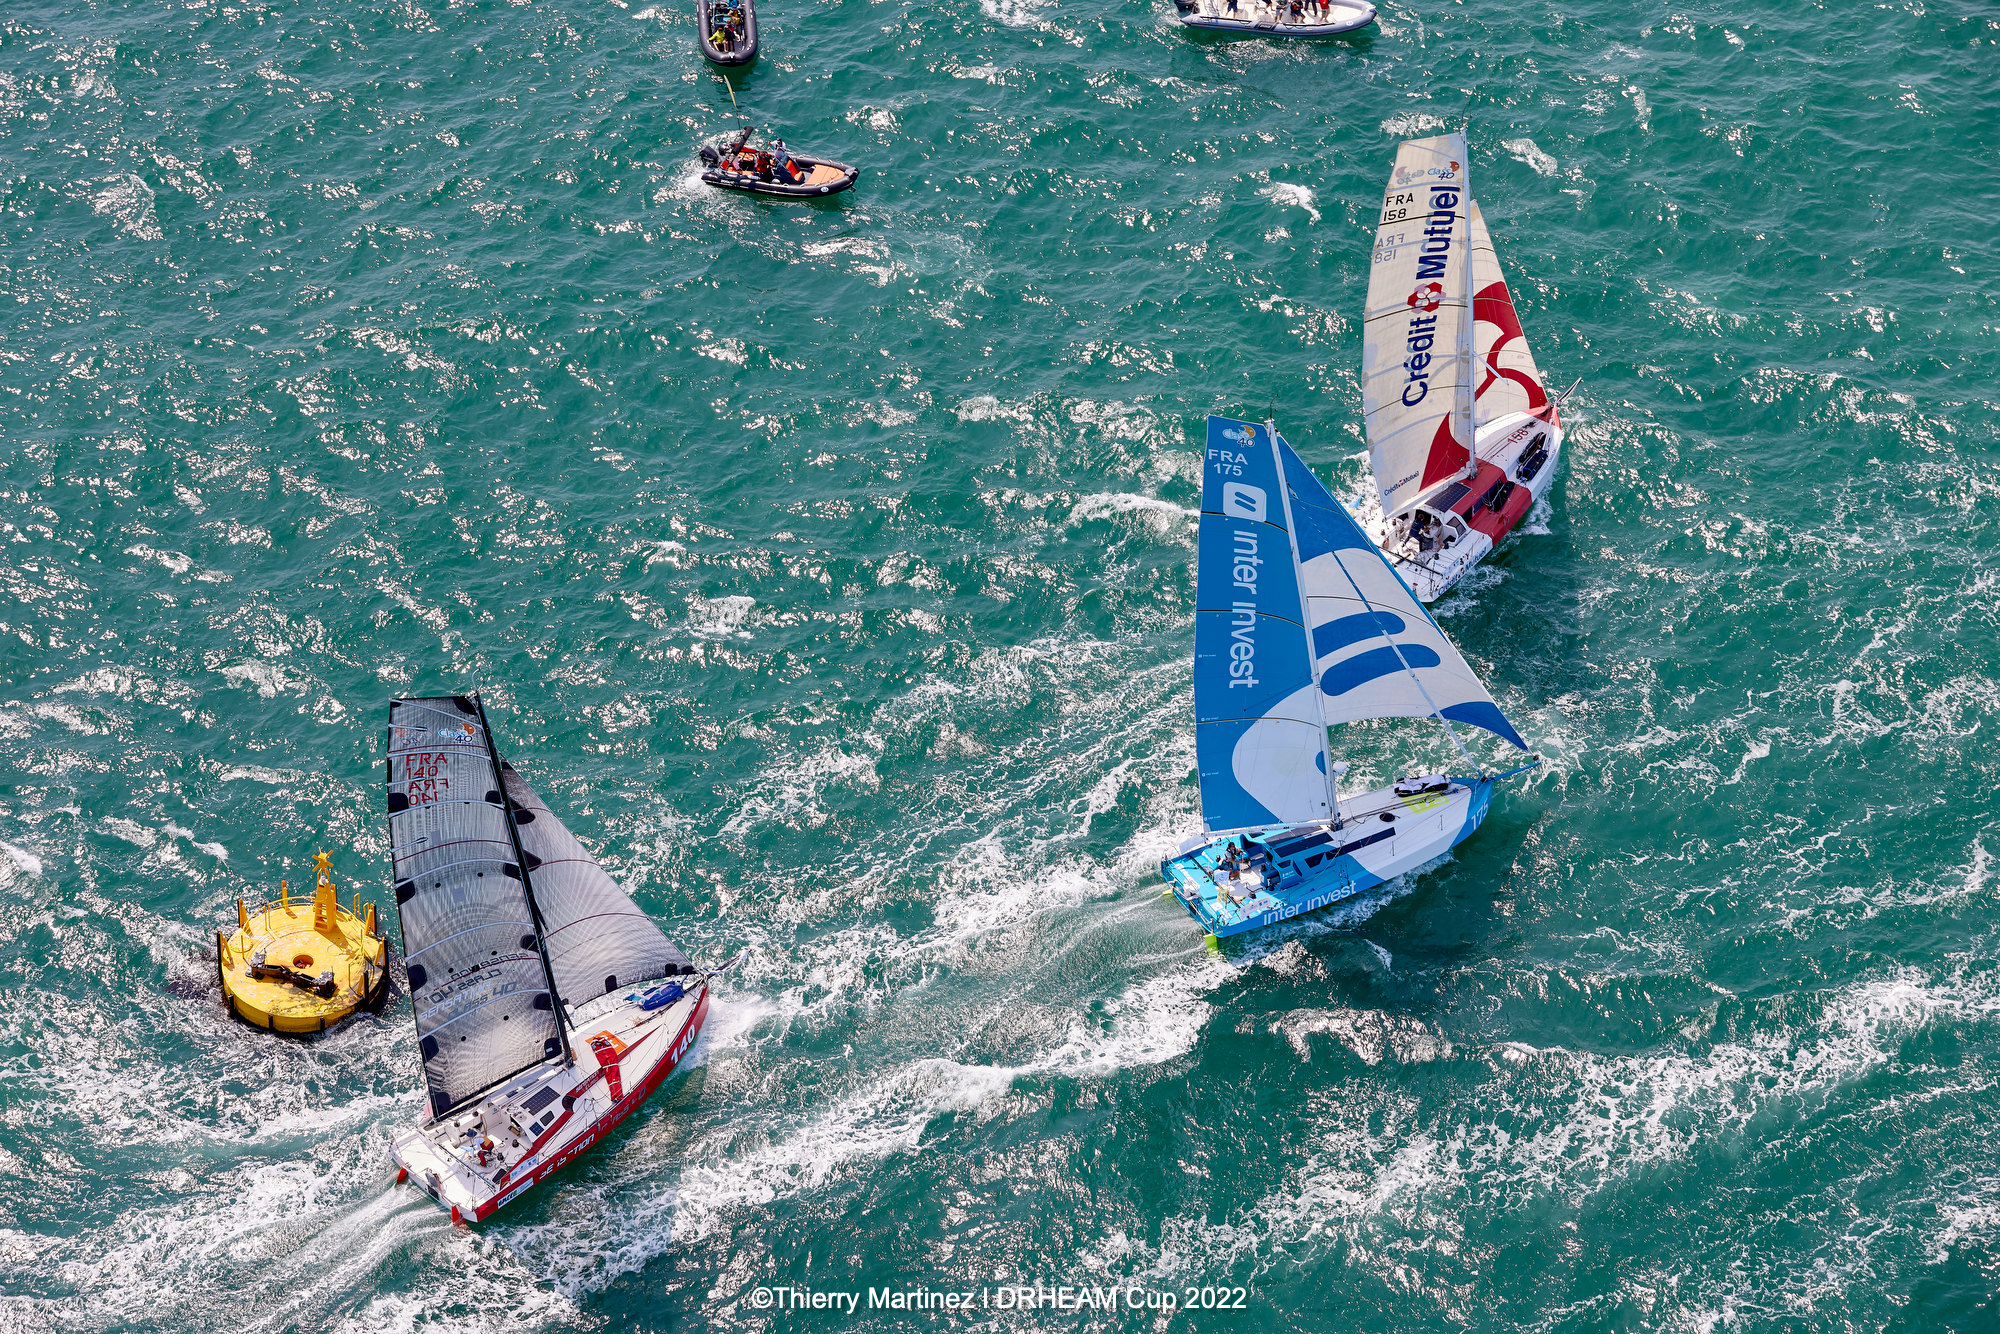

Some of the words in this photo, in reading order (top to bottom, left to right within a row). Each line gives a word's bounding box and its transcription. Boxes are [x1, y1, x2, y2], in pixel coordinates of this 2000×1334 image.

[1438, 171, 1455, 180] 40
[1385, 192, 1414, 207] FRA
[1383, 208, 1407, 222] 158
[1416, 186, 1461, 280] Mutuel
[1402, 315, 1437, 407] Crédit
[1237, 437, 1256, 447] 40
[1507, 428, 1529, 444] 158
[1208, 448, 1248, 465] FRA
[1213, 463, 1242, 476] 175
[438, 728, 468, 738] Class
[454, 735, 473, 744] 40
[406, 752, 448, 766] FRA
[406, 765, 439, 779] 140
[1470, 800, 1489, 831] 175
[419, 981, 492, 1020] SENSATION
[670, 1024, 696, 1065] 140
